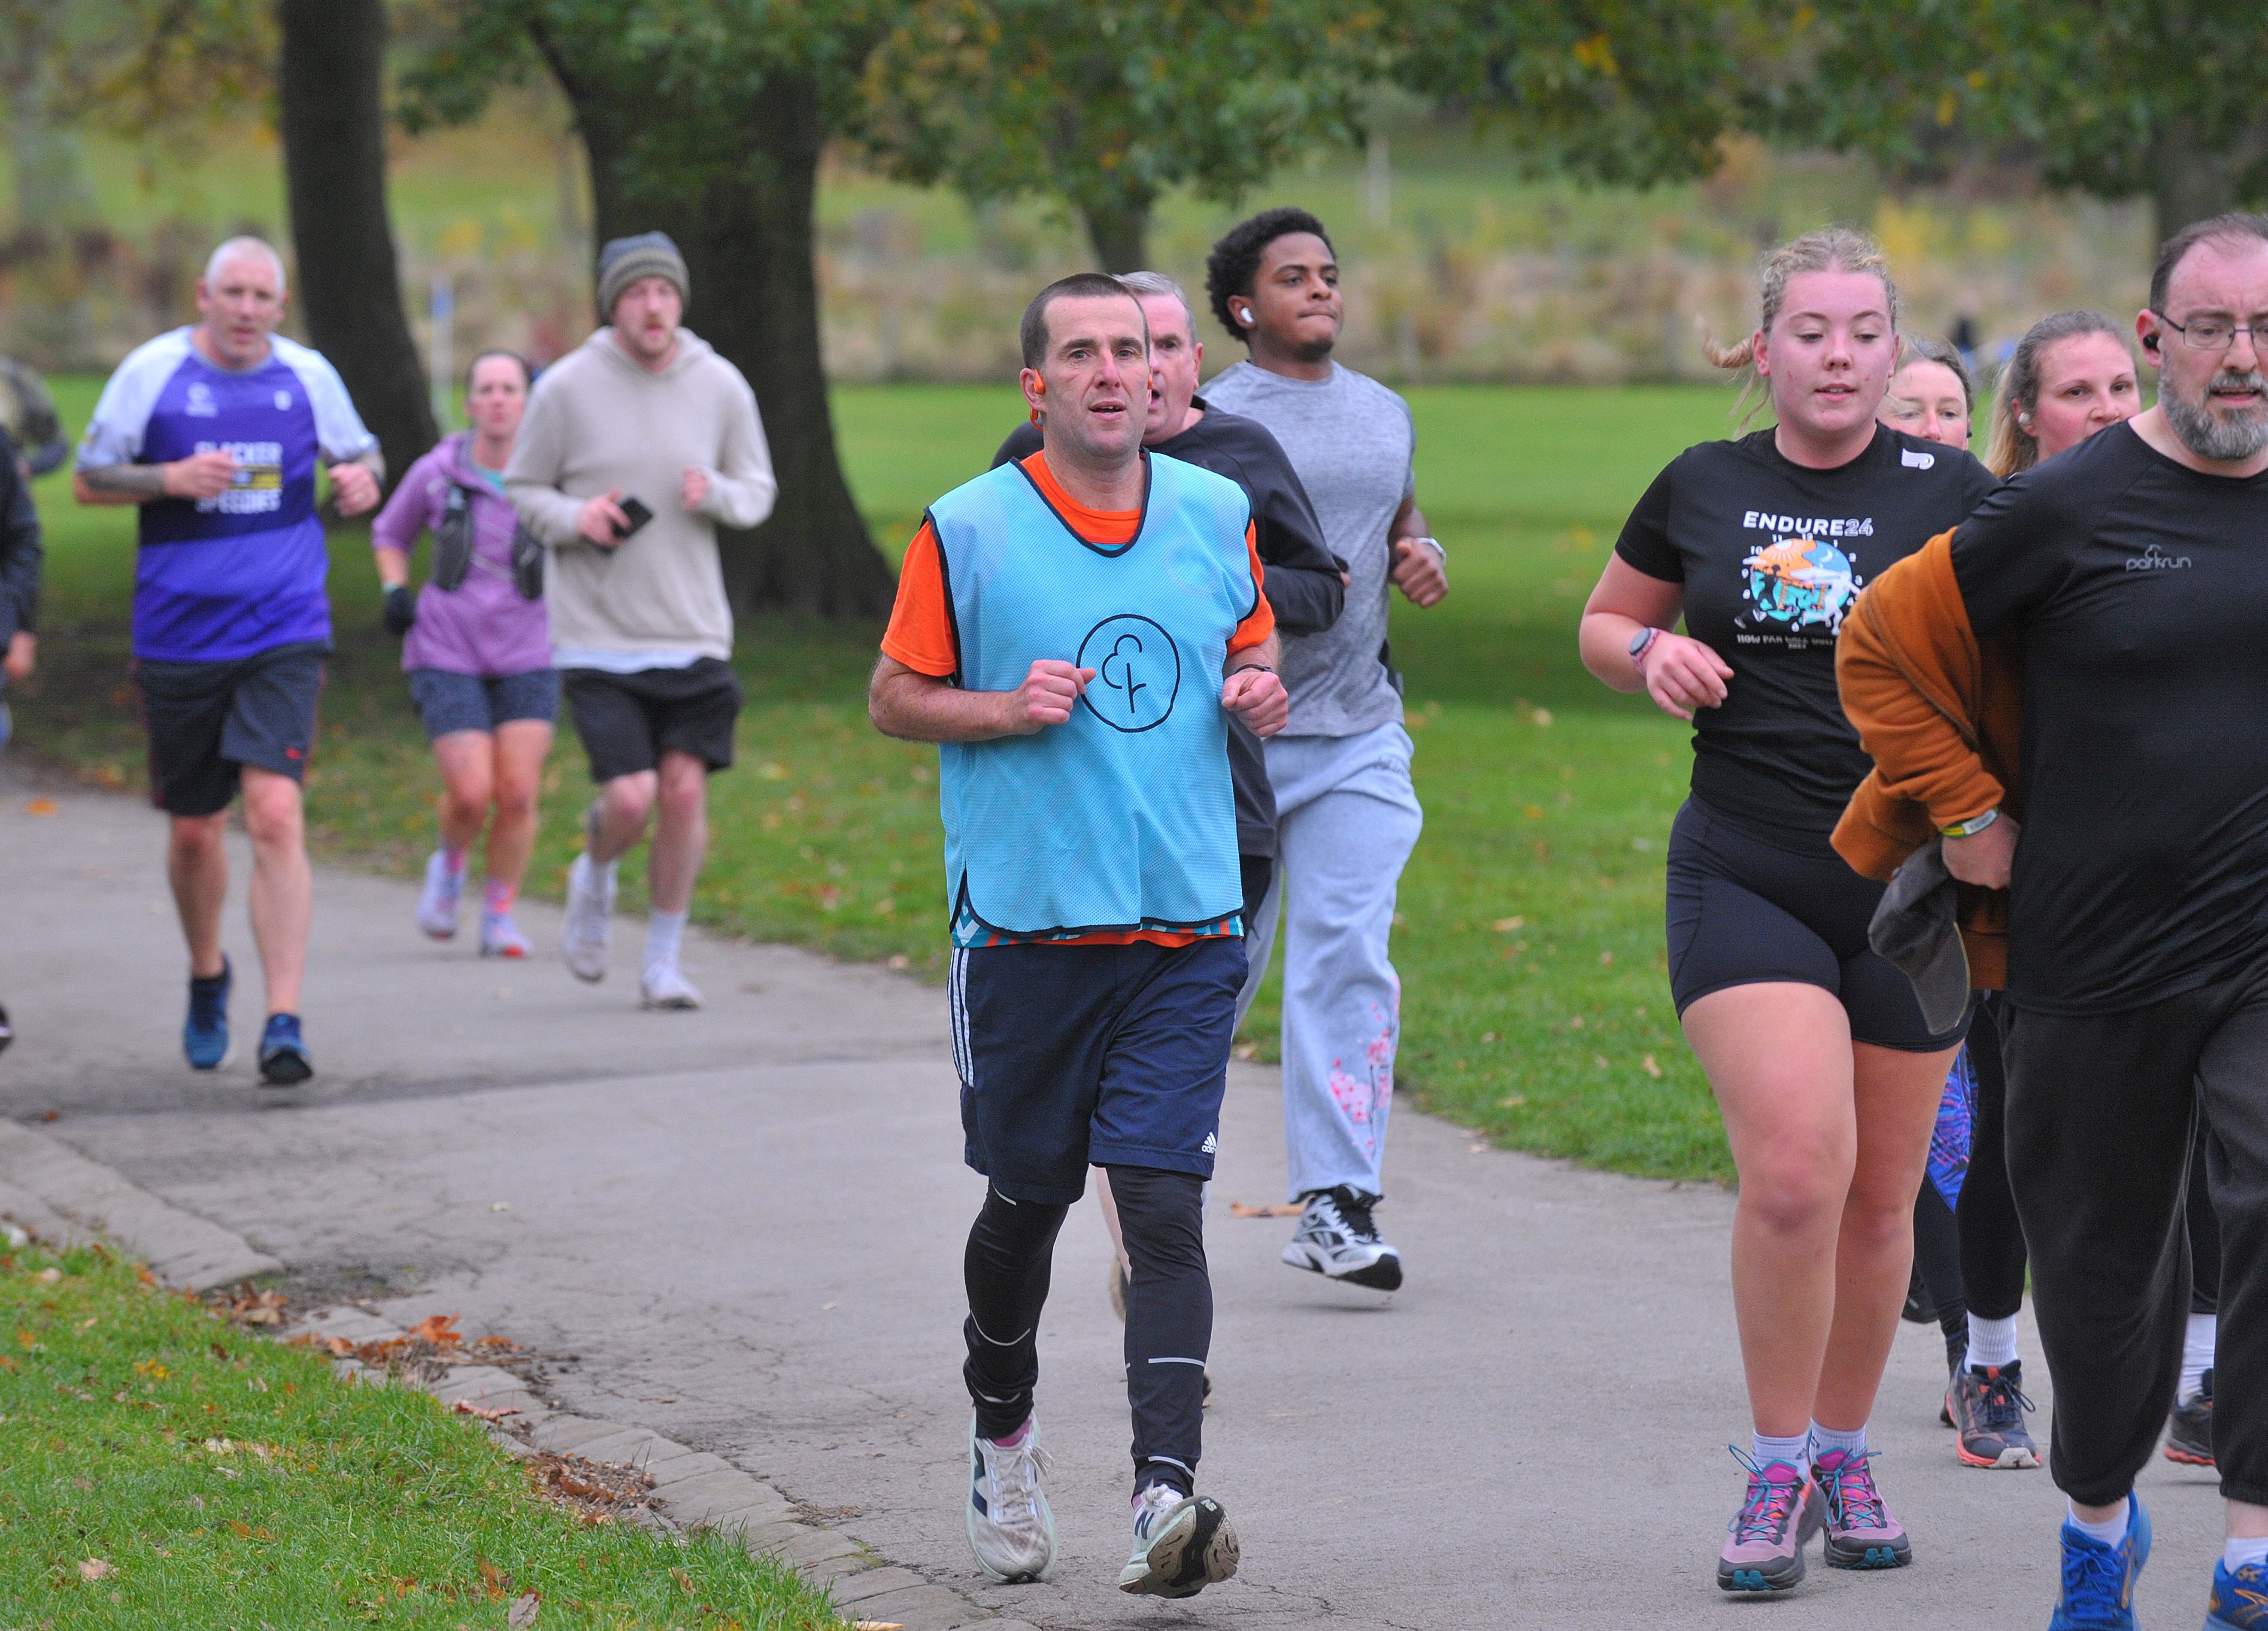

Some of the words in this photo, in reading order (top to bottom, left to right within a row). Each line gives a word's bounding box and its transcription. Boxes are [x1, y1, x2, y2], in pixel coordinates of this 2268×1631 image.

[1743, 511, 1873, 536] ENDURE24
[1751, 545, 1763, 555] 10
[2126, 544, 2191, 572] parkrun
[1737, 635, 1760, 644] HOW
[1762, 635, 1782, 643] FAR
